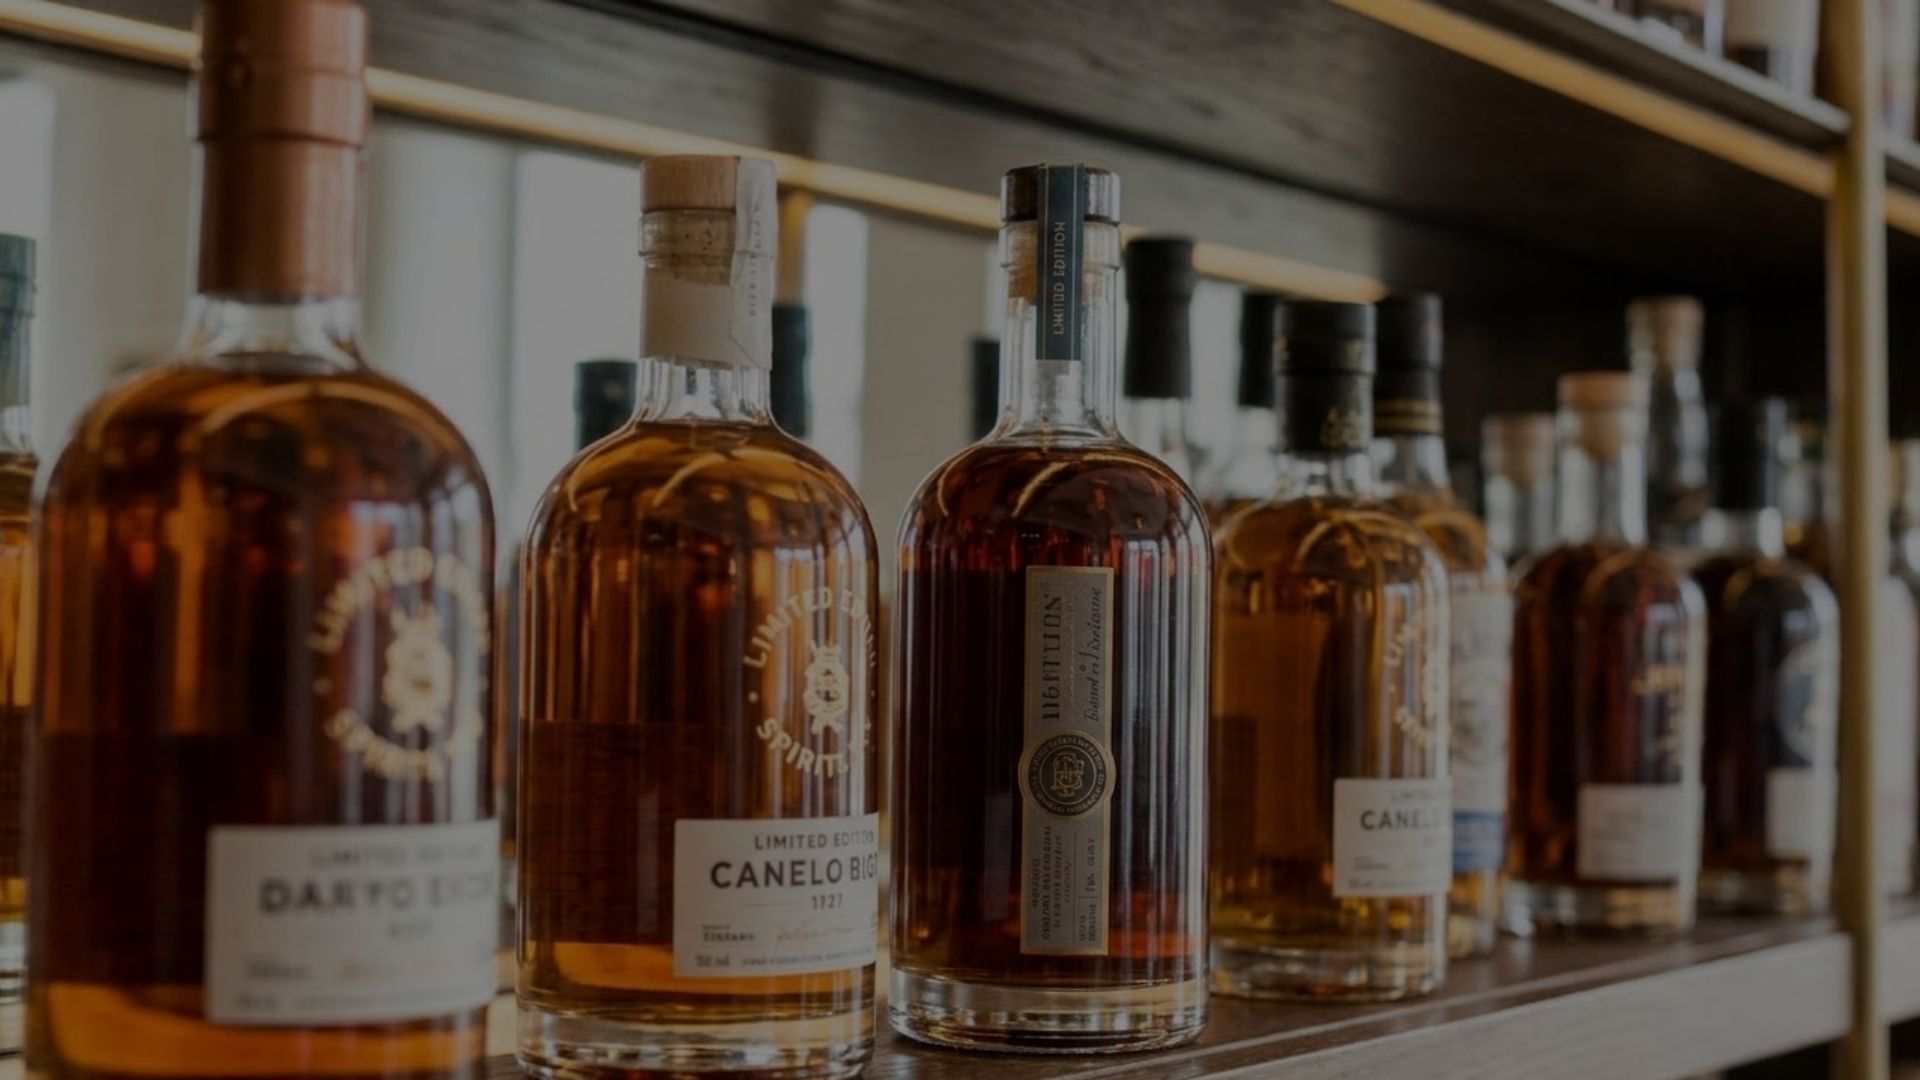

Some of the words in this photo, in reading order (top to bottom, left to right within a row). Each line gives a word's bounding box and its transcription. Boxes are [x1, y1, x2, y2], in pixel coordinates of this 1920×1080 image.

[742, 587, 833, 670] LIMITED
[754, 832, 828, 850] LIMITED
[709, 857, 843, 889] CANELO
